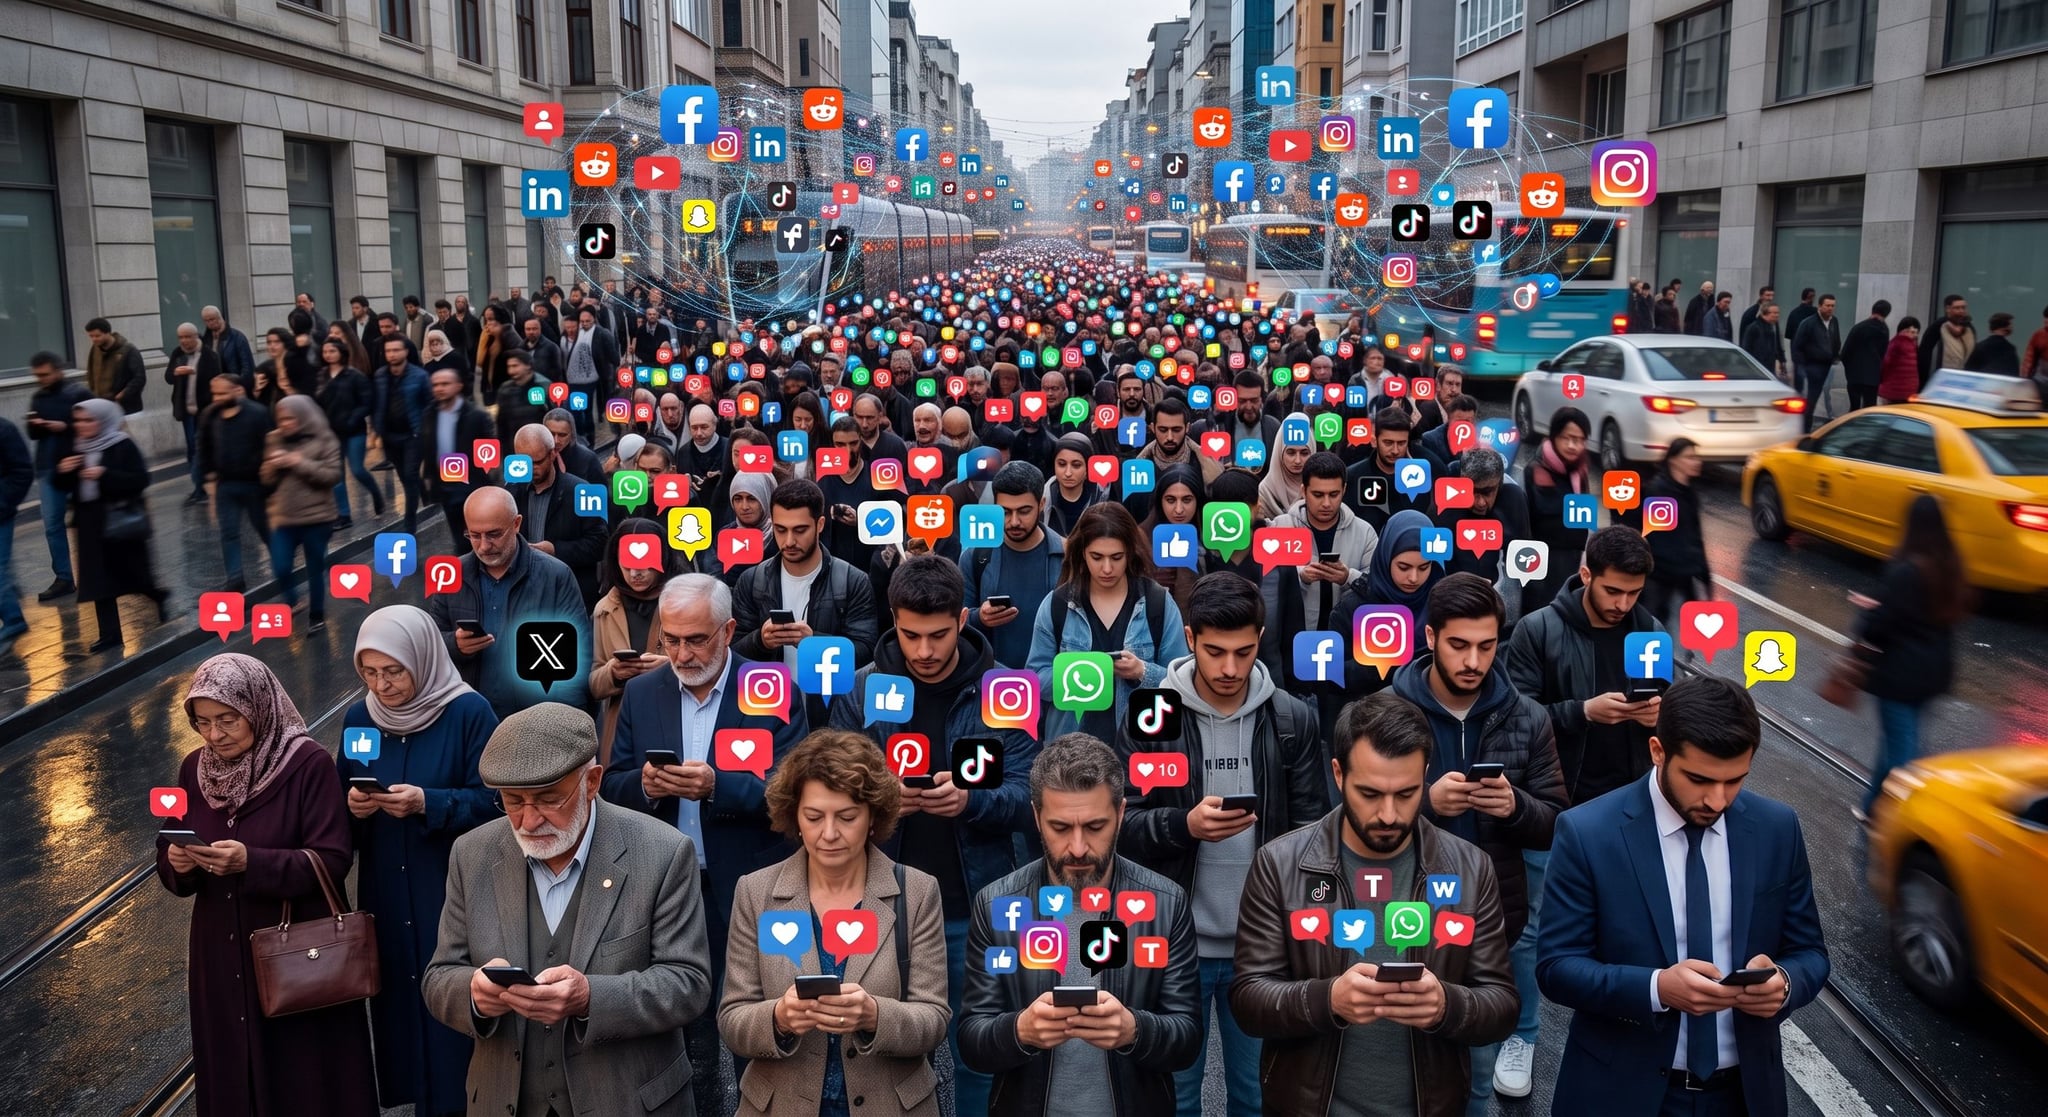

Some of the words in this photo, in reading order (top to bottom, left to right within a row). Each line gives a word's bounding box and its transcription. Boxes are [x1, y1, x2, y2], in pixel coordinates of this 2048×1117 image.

[1262, 73, 1290, 97] in
[678, 97, 703, 145] f
[1467, 100, 1492, 148] f
[755, 133, 780, 156] in
[906, 135, 921, 161] f
[1384, 125, 1413, 152] in
[962, 158, 977, 172] in
[529, 178, 561, 210] in
[1226, 169, 1243, 202] f
[1318, 179, 1330, 200] f
[1172, 198, 1184, 209] in
[1349, 391, 1363, 403] in
[1127, 422, 1137, 445] f
[1289, 424, 1304, 441] in
[783, 437, 802, 455] in
[1131, 466, 1148, 484] in
[581, 490, 601, 510] in
[1569, 501, 1591, 522] in
[970, 516, 994, 539] in
[1481, 530, 1495, 540] 13
[388, 540, 406, 573] f
[1285, 541, 1302, 552] 12
[530, 634, 564, 669] X
[1312, 639, 1333, 680] f
[1640, 641, 1660, 678] f
[815, 647, 840, 695] f
[1159, 764, 1177, 776] 10
[1365, 875, 1382, 897] T
[1433, 882, 1455, 897] W
[1006, 902, 1021, 931] f
[1142, 943, 1159, 962] T
